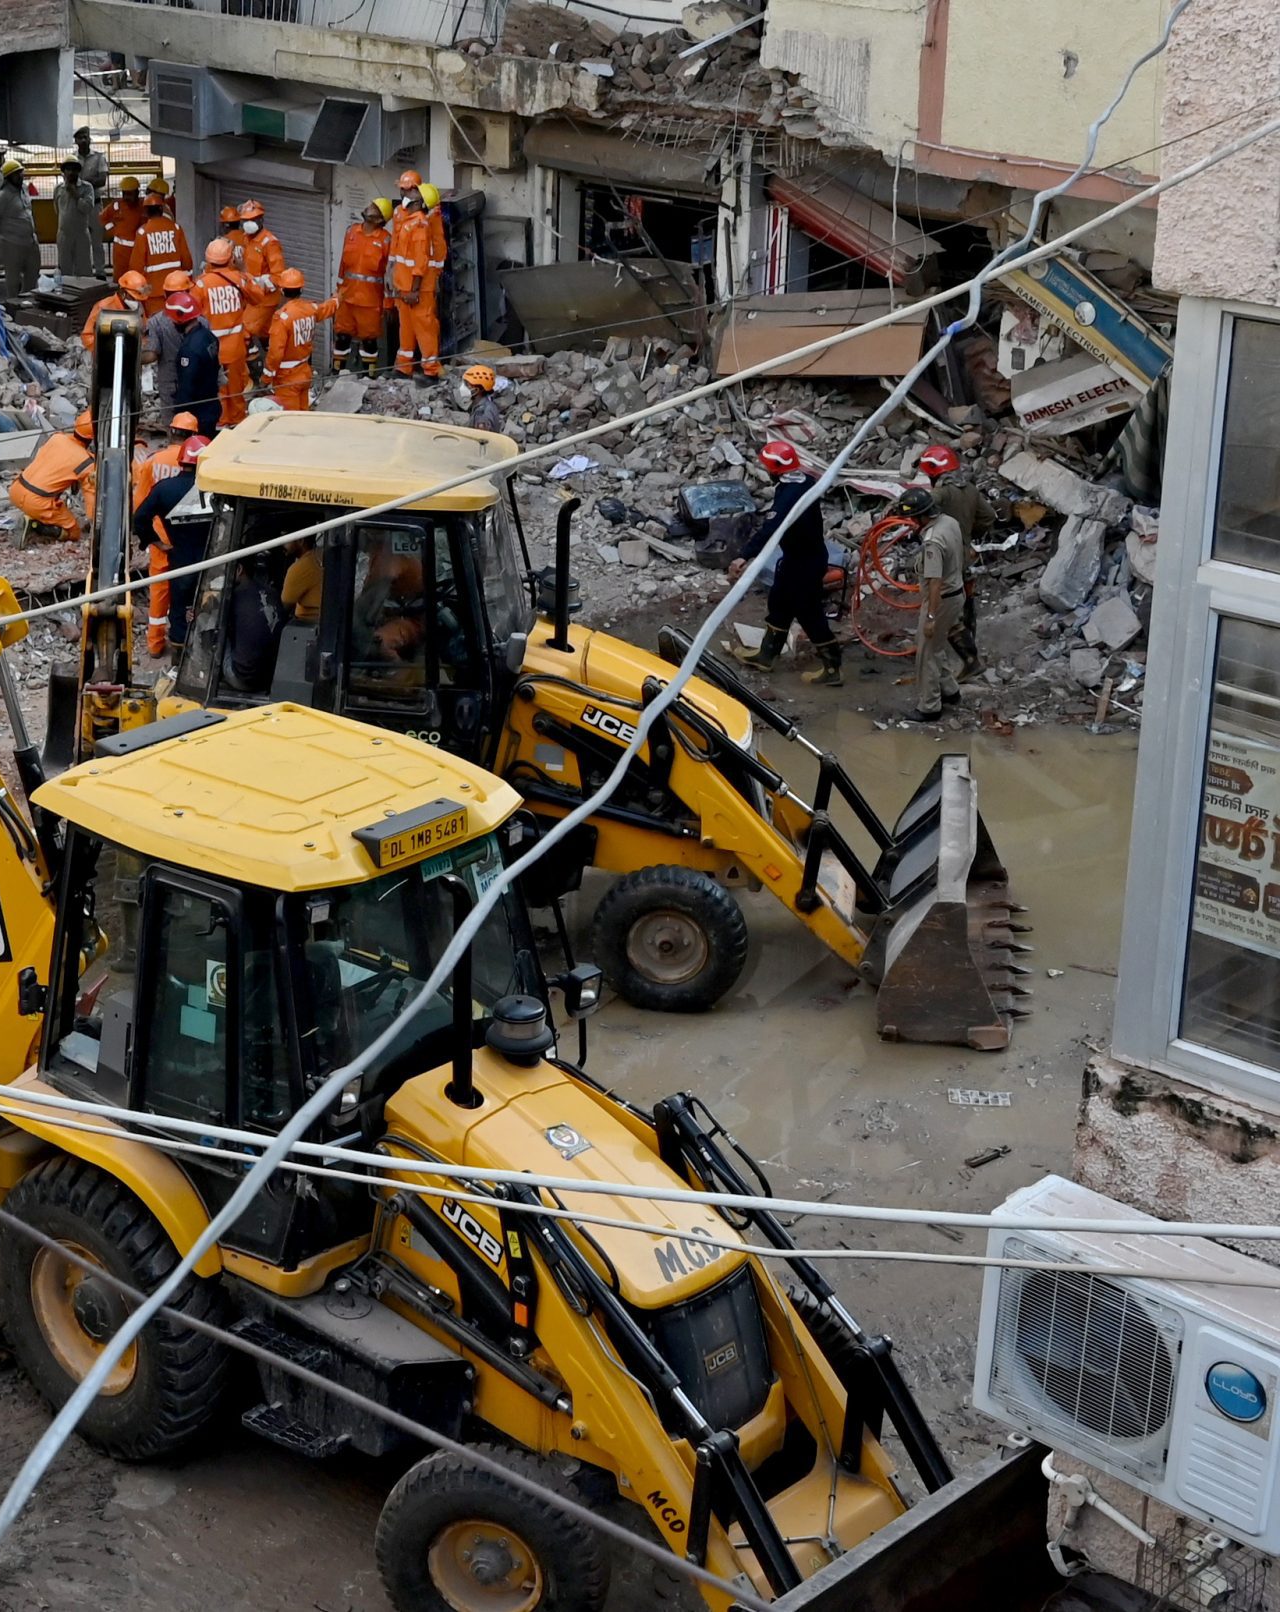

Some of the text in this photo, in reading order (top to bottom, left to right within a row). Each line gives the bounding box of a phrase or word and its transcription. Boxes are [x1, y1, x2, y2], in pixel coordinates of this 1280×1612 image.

[147, 231, 175, 246] NDRF
[148, 240, 176, 255] INDIA
[210, 298, 241, 315] INDIA
[1015, 286, 1056, 321] RAMESH
[1055, 316, 1112, 366] ELECTRICAL
[1023, 378, 1130, 425] RAMESH ELECTR
[152, 463, 183, 478] NDR
[405, 729, 441, 744] eco
[583, 710, 639, 744] JCB
[390, 816, 465, 859] DL 1MB 5481
[442, 1201, 503, 1264] JCB
[707, 1347, 735, 1371] JCB
[1212, 1377, 1258, 1403] LLOYD
[646, 1490, 686, 1533] MCD
